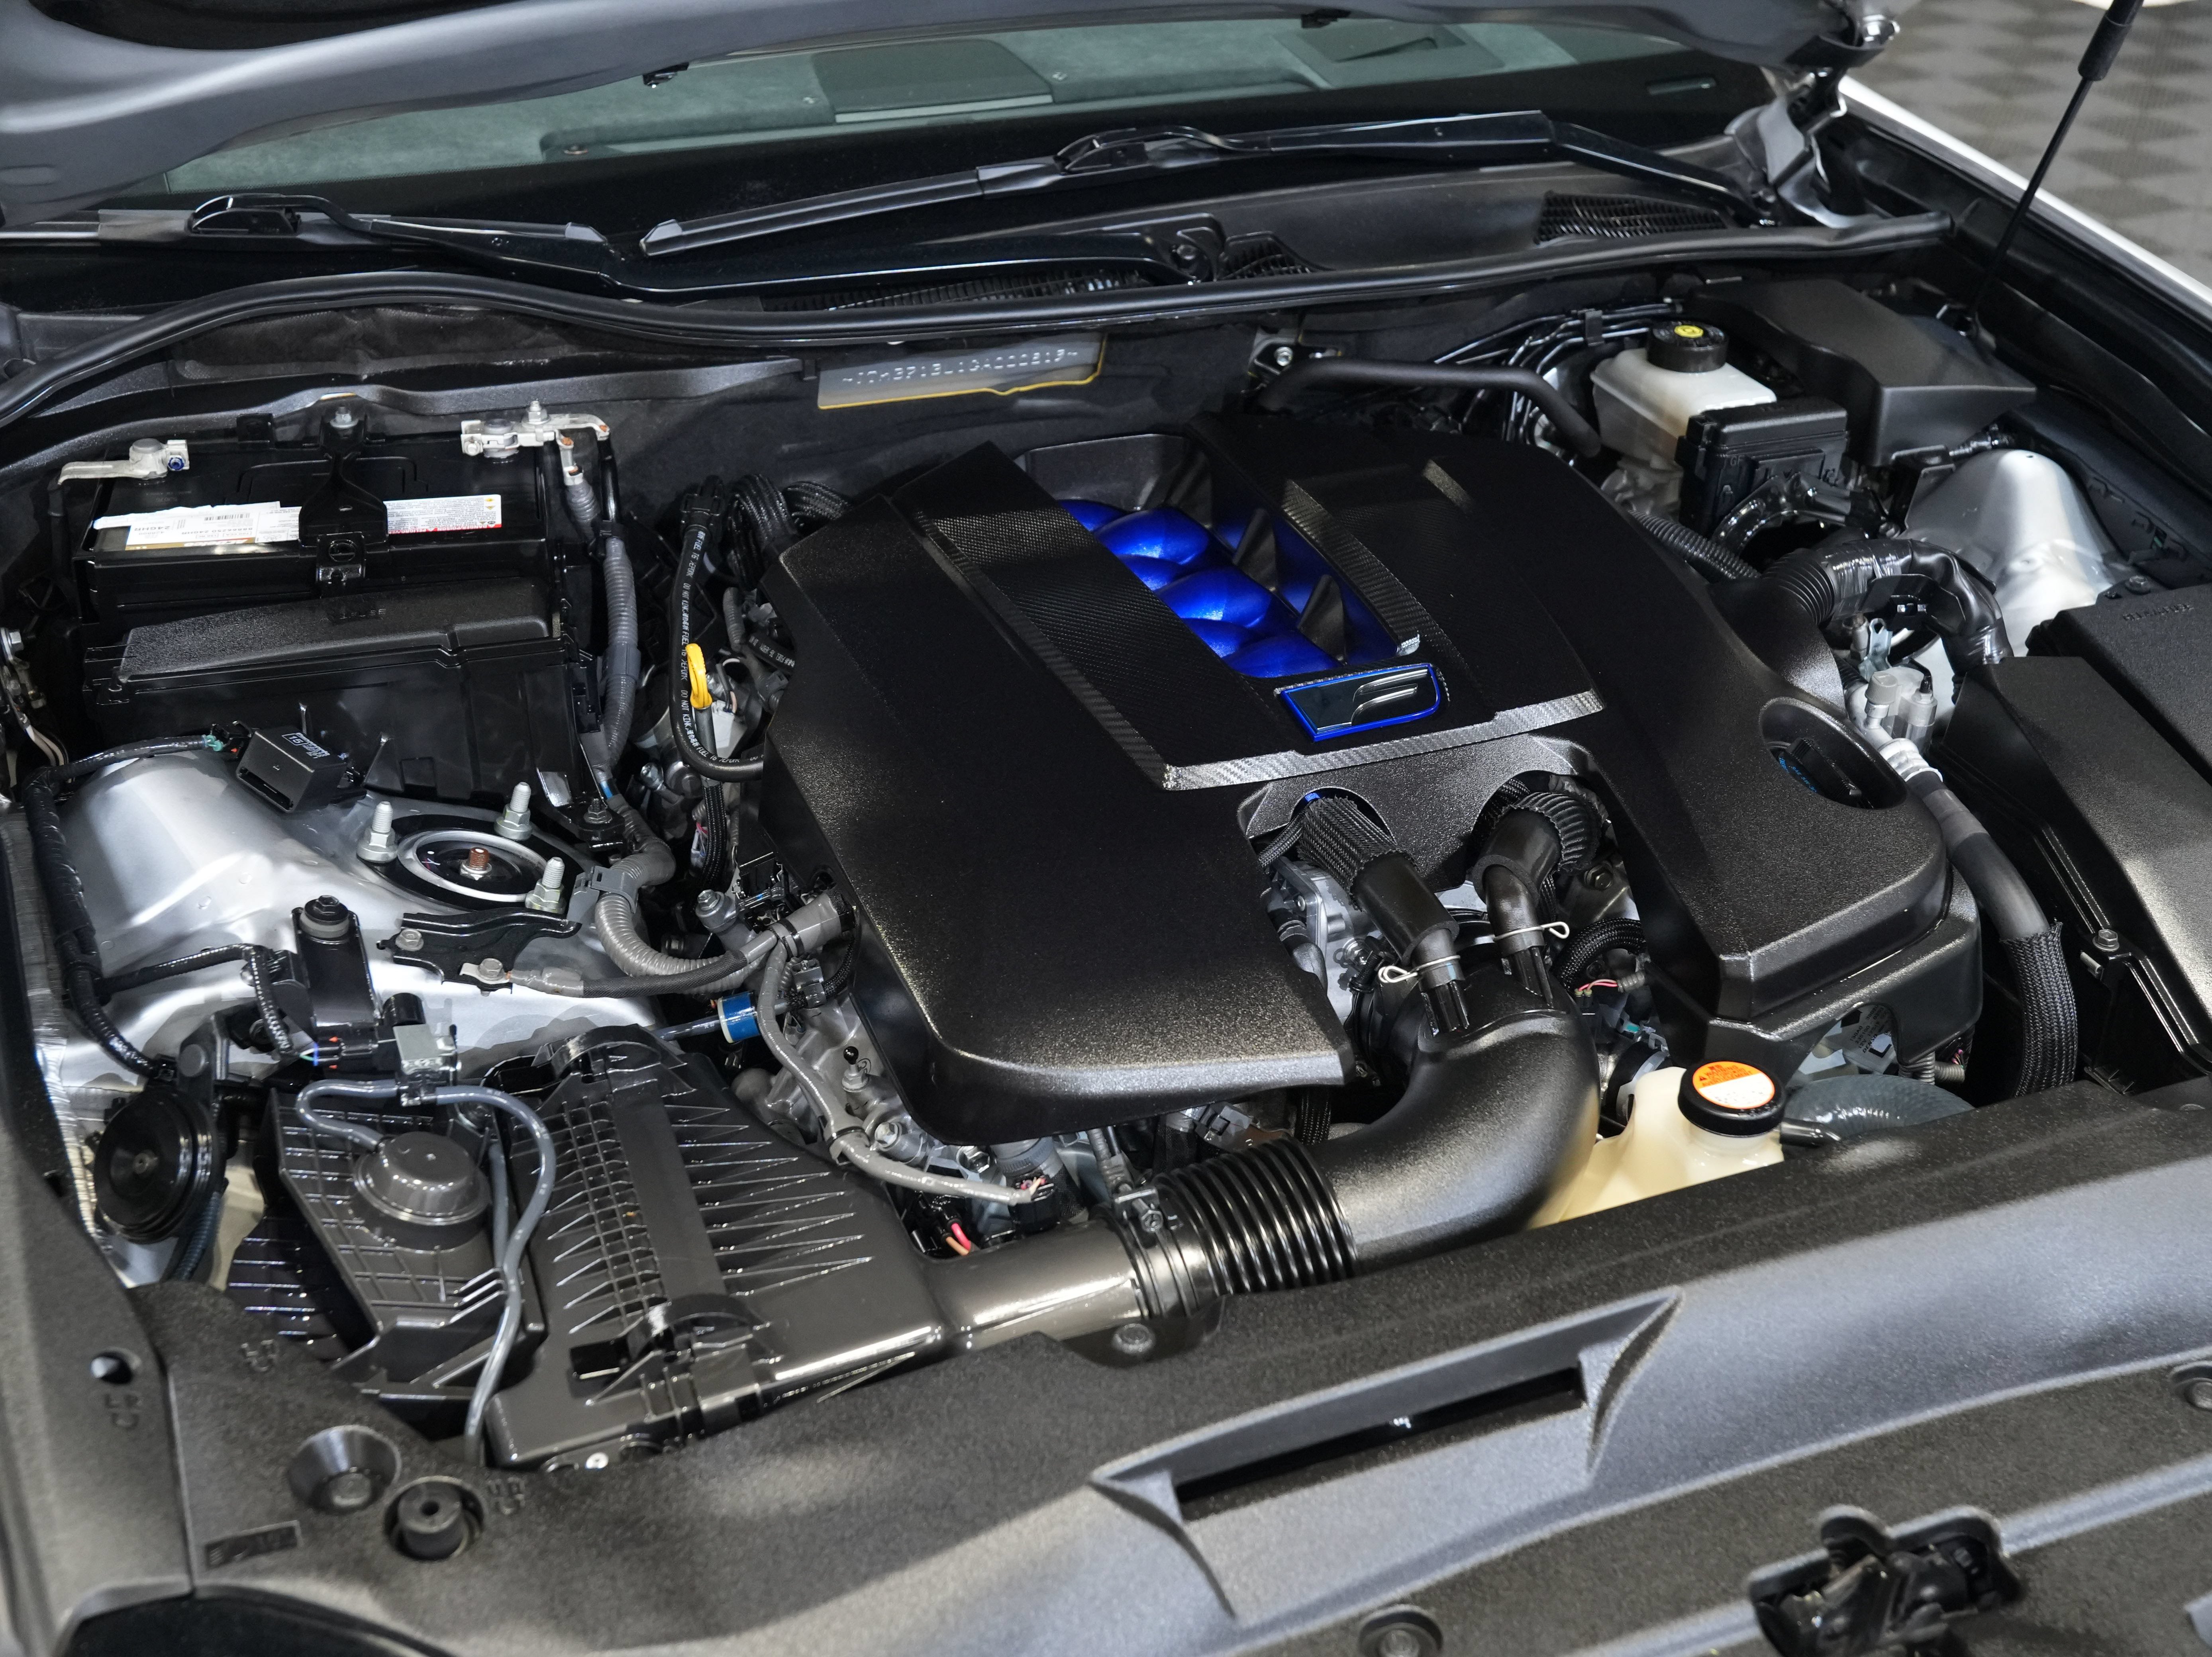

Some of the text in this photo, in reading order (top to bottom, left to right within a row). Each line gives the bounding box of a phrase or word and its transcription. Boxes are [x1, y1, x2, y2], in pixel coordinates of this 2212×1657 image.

[693, 539, 703, 550] FUEL
[680, 689, 688, 698] DO
[681, 700, 689, 711] NOT
[696, 746, 710, 758] FUEL
[1863, 1033, 1877, 1053] DENSO
